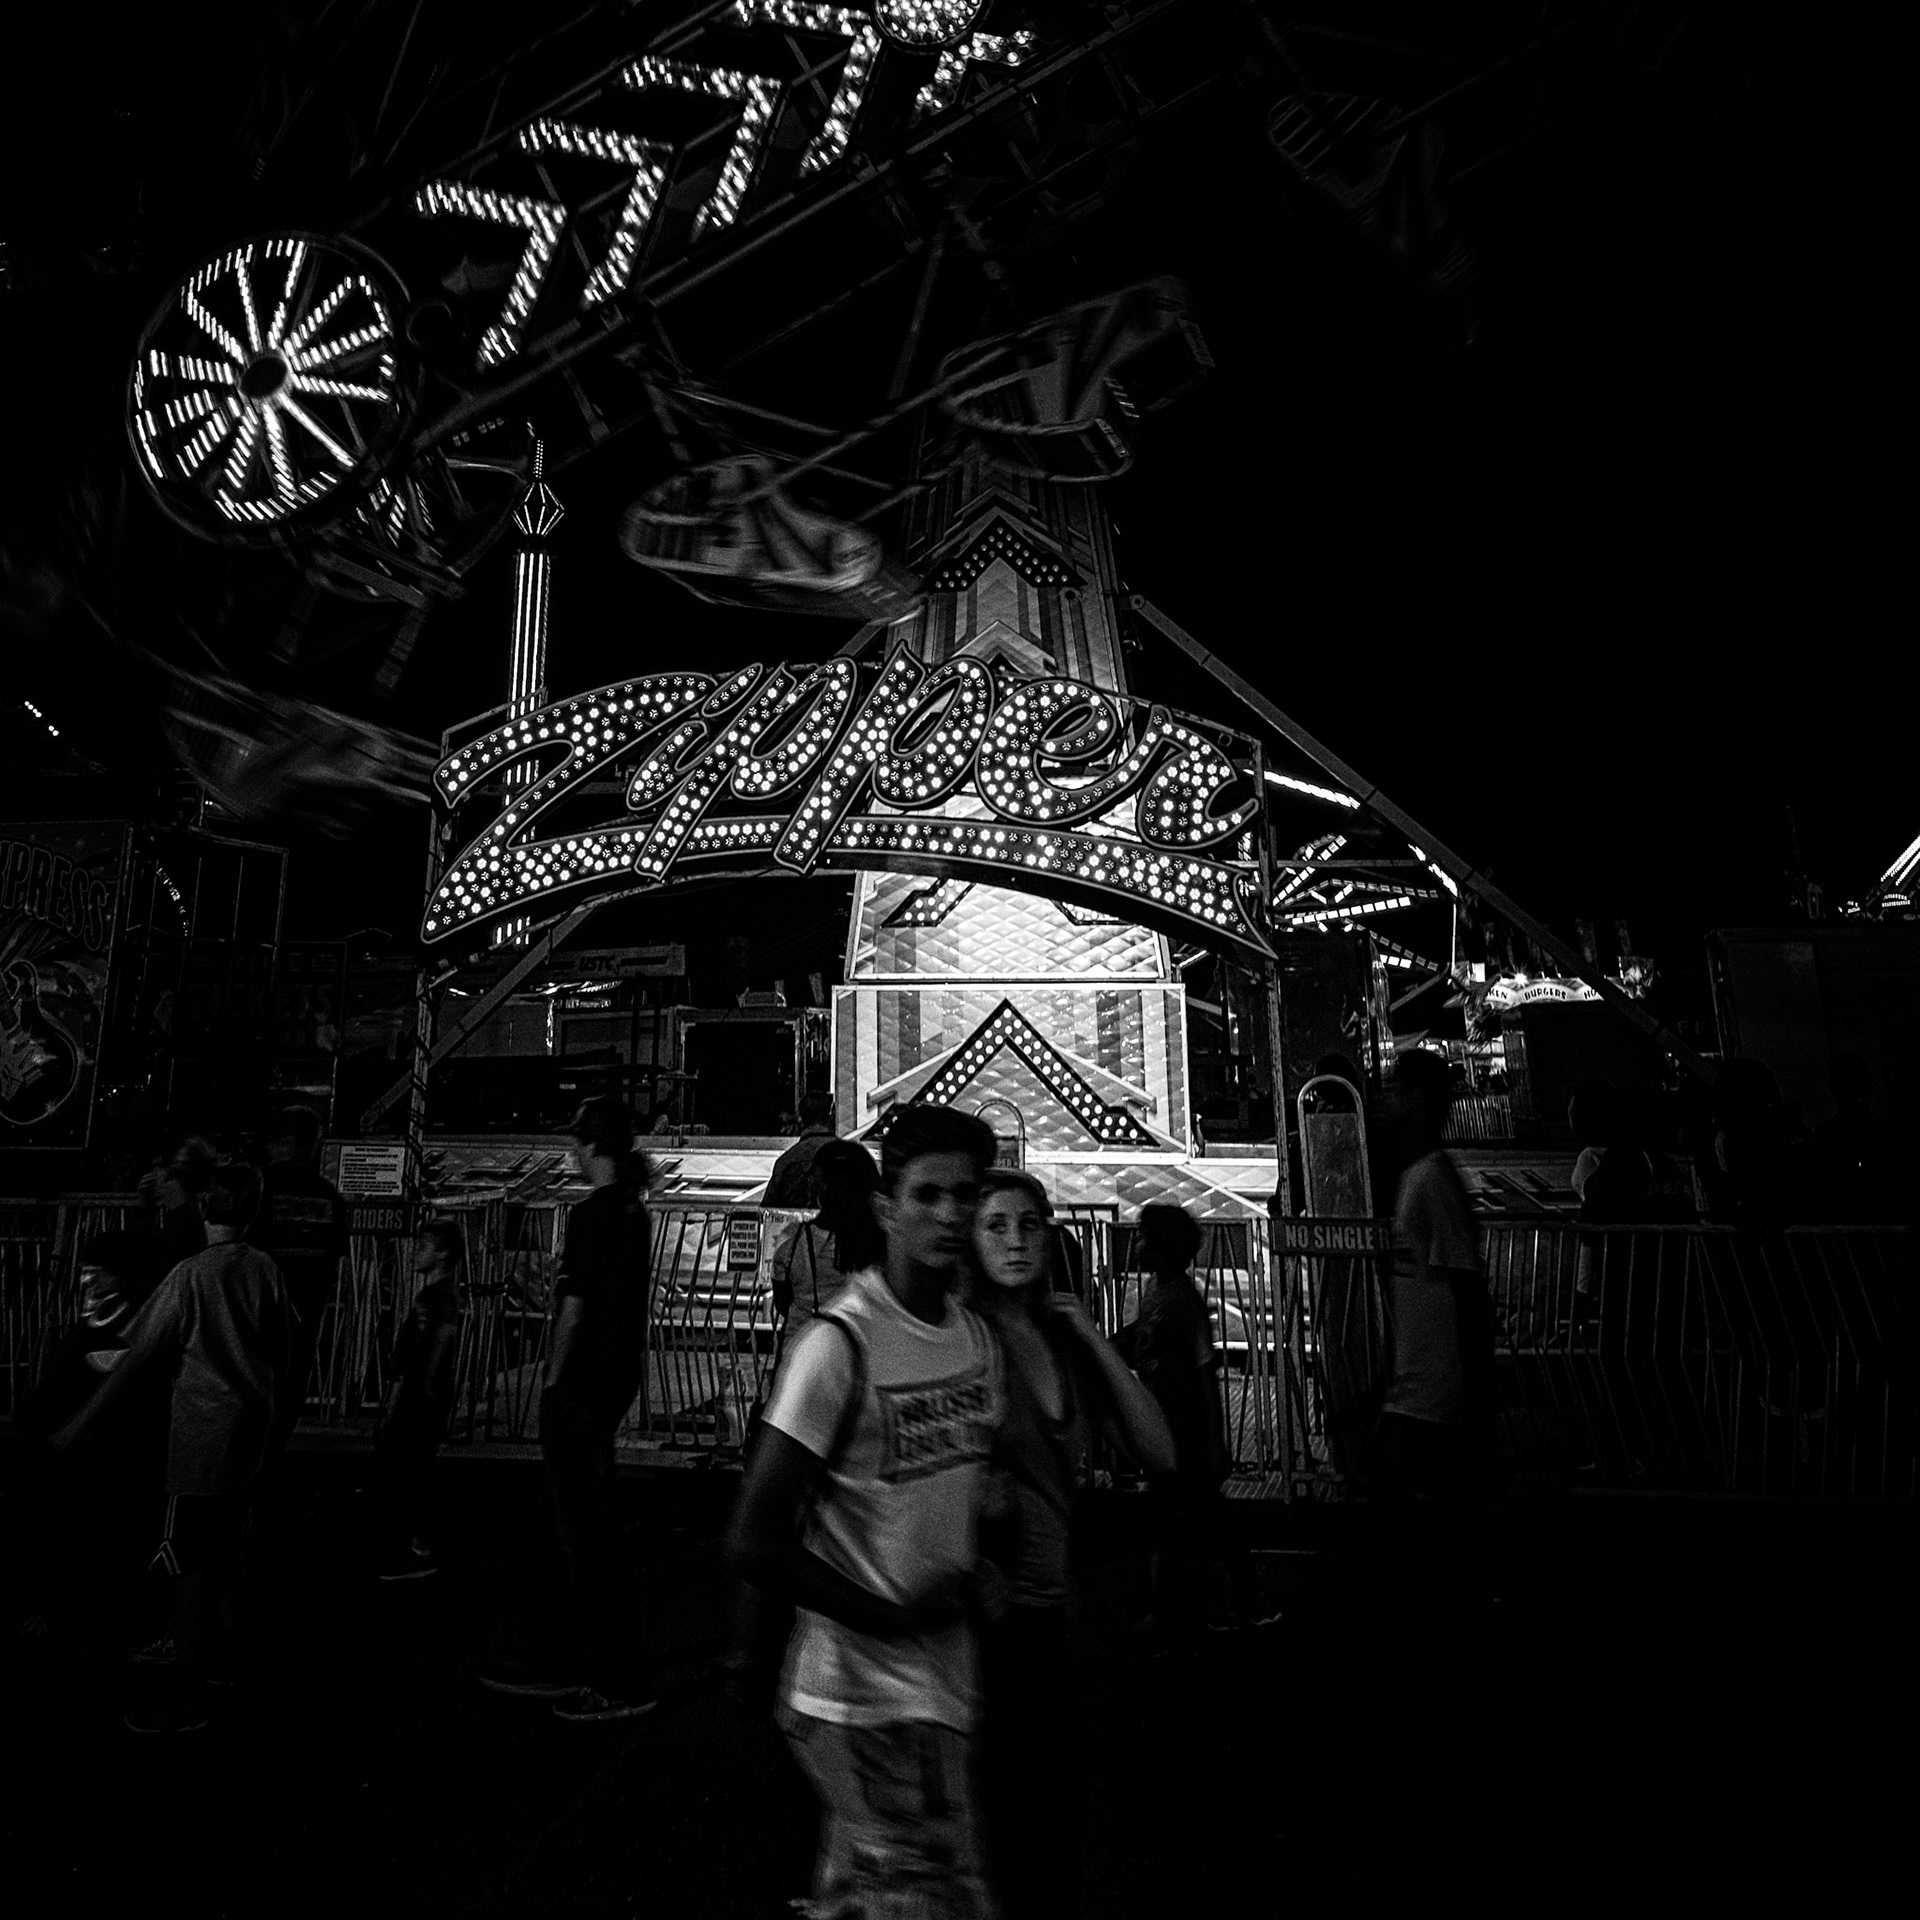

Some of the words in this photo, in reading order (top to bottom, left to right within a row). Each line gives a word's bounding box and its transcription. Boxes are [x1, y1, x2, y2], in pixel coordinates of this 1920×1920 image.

[421, 640, 1270, 946] Zipper
[1523, 988, 1567, 1001] BURGERS
[352, 1207, 404, 1231] RIDERS
[1284, 1224, 1309, 1249] NO
[1312, 1225, 1375, 1251] SINGLE
